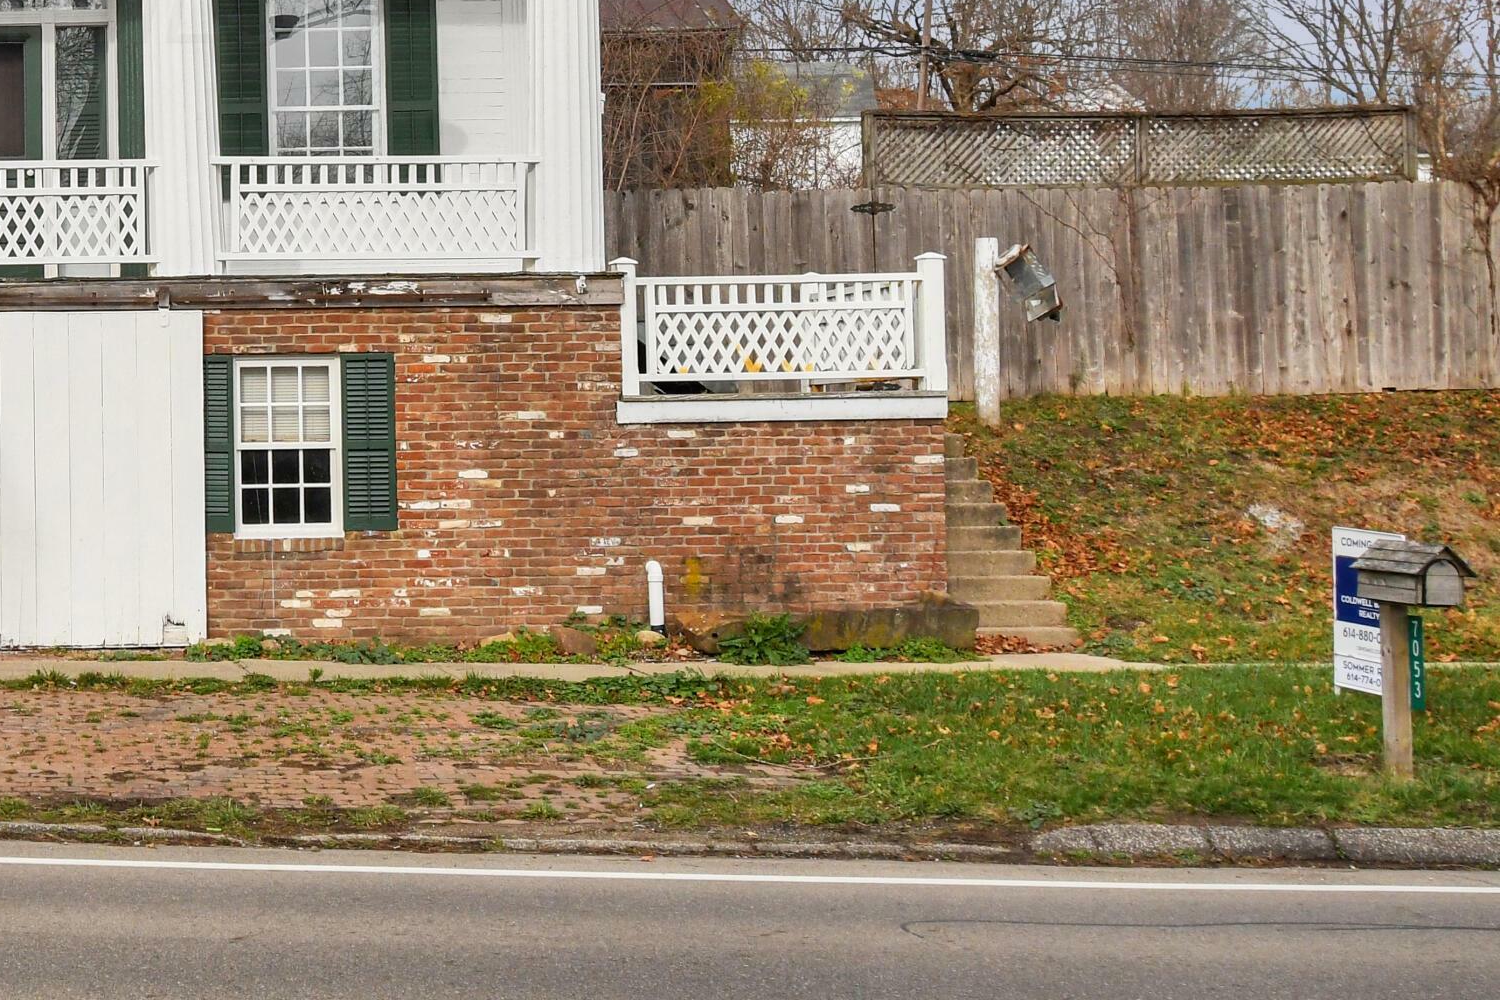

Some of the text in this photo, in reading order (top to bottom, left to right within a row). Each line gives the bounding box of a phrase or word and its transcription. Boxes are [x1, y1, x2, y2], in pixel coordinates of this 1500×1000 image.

[1340, 595, 1373, 607] COLDWELL
[1358, 610, 1380, 620] REALTY
[1411, 620, 1421, 698] 7053
[1342, 660, 1374, 674] SOMMER
